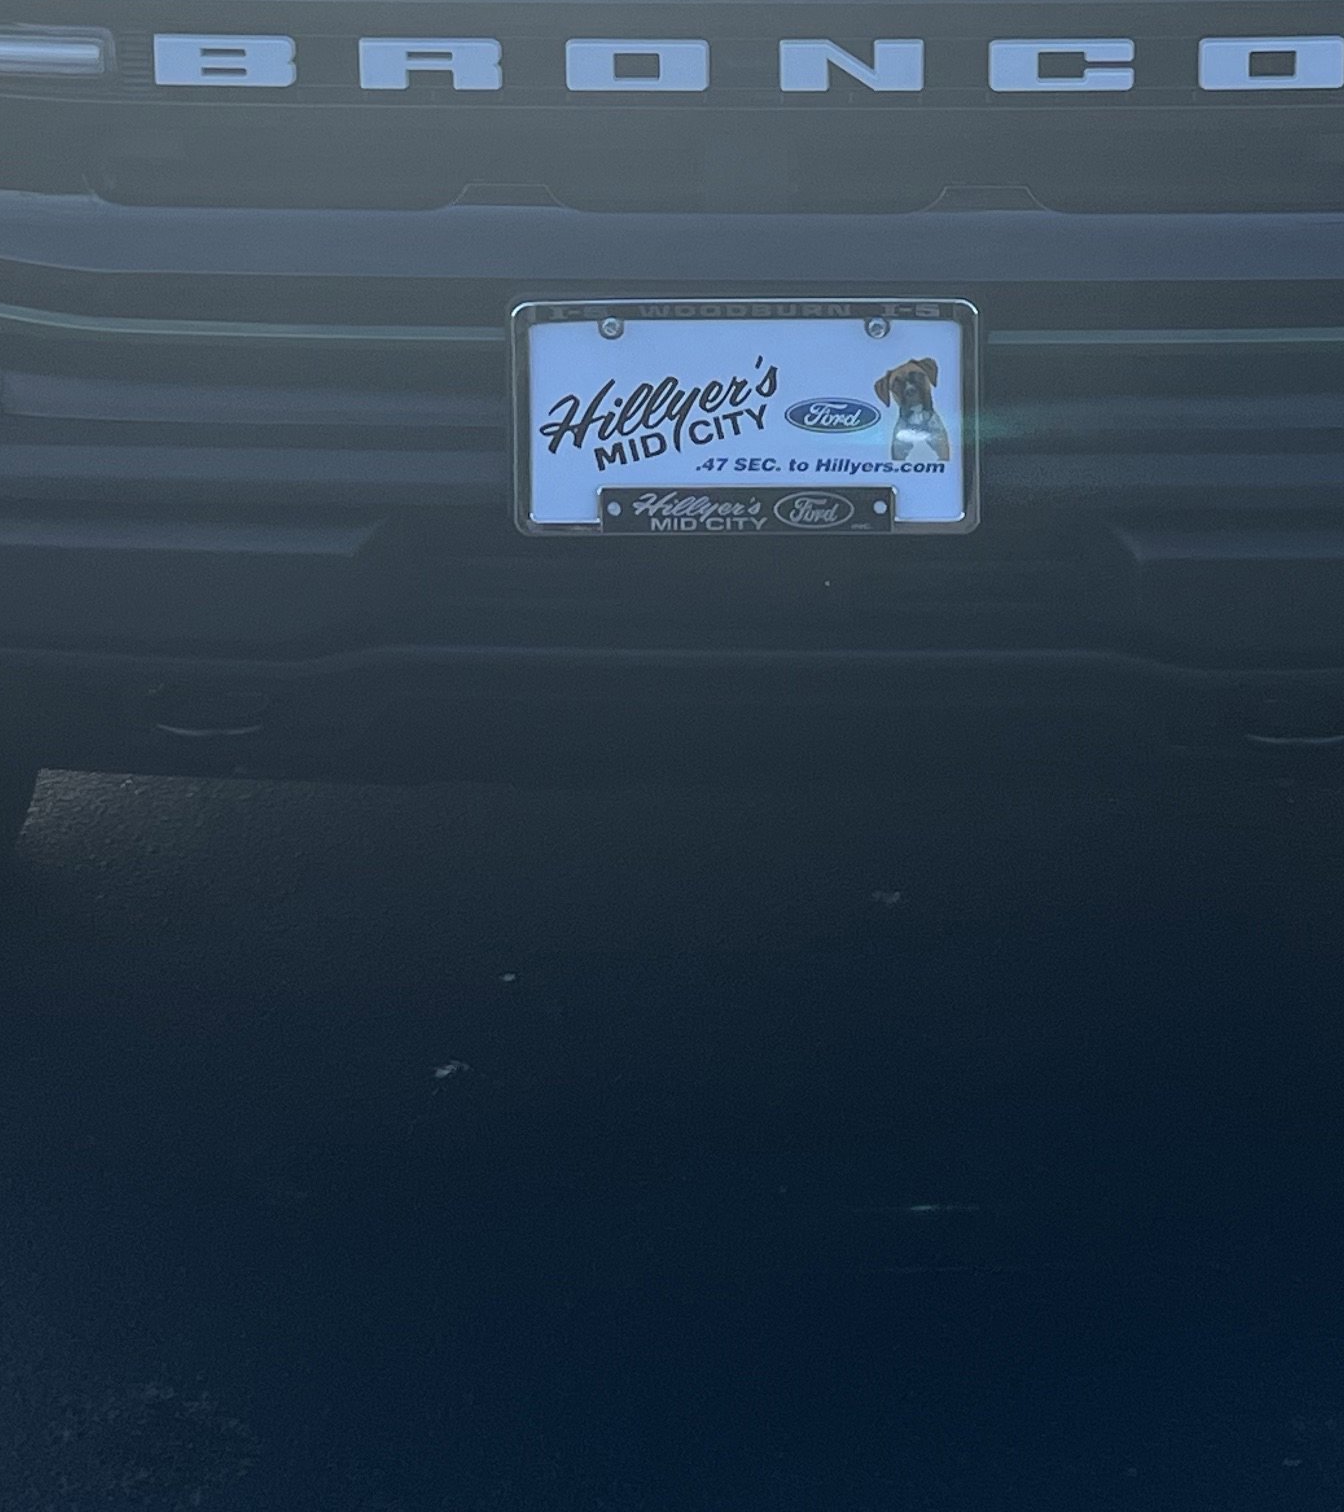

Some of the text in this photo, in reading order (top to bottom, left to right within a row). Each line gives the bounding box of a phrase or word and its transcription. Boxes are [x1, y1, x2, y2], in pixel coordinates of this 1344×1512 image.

[638, 303, 851, 318] WOODBURN
[881, 303, 940, 317] I-5
[539, 355, 779, 454] Hillyer's
[594, 404, 767, 471] MID CITY
[734, 458, 781, 472] SEC.
[789, 459, 809, 472] to
[816, 458, 945, 475] Hillyers.com
[633, 491, 762, 522] Hillyer's
[650, 517, 768, 531] MID CITY
